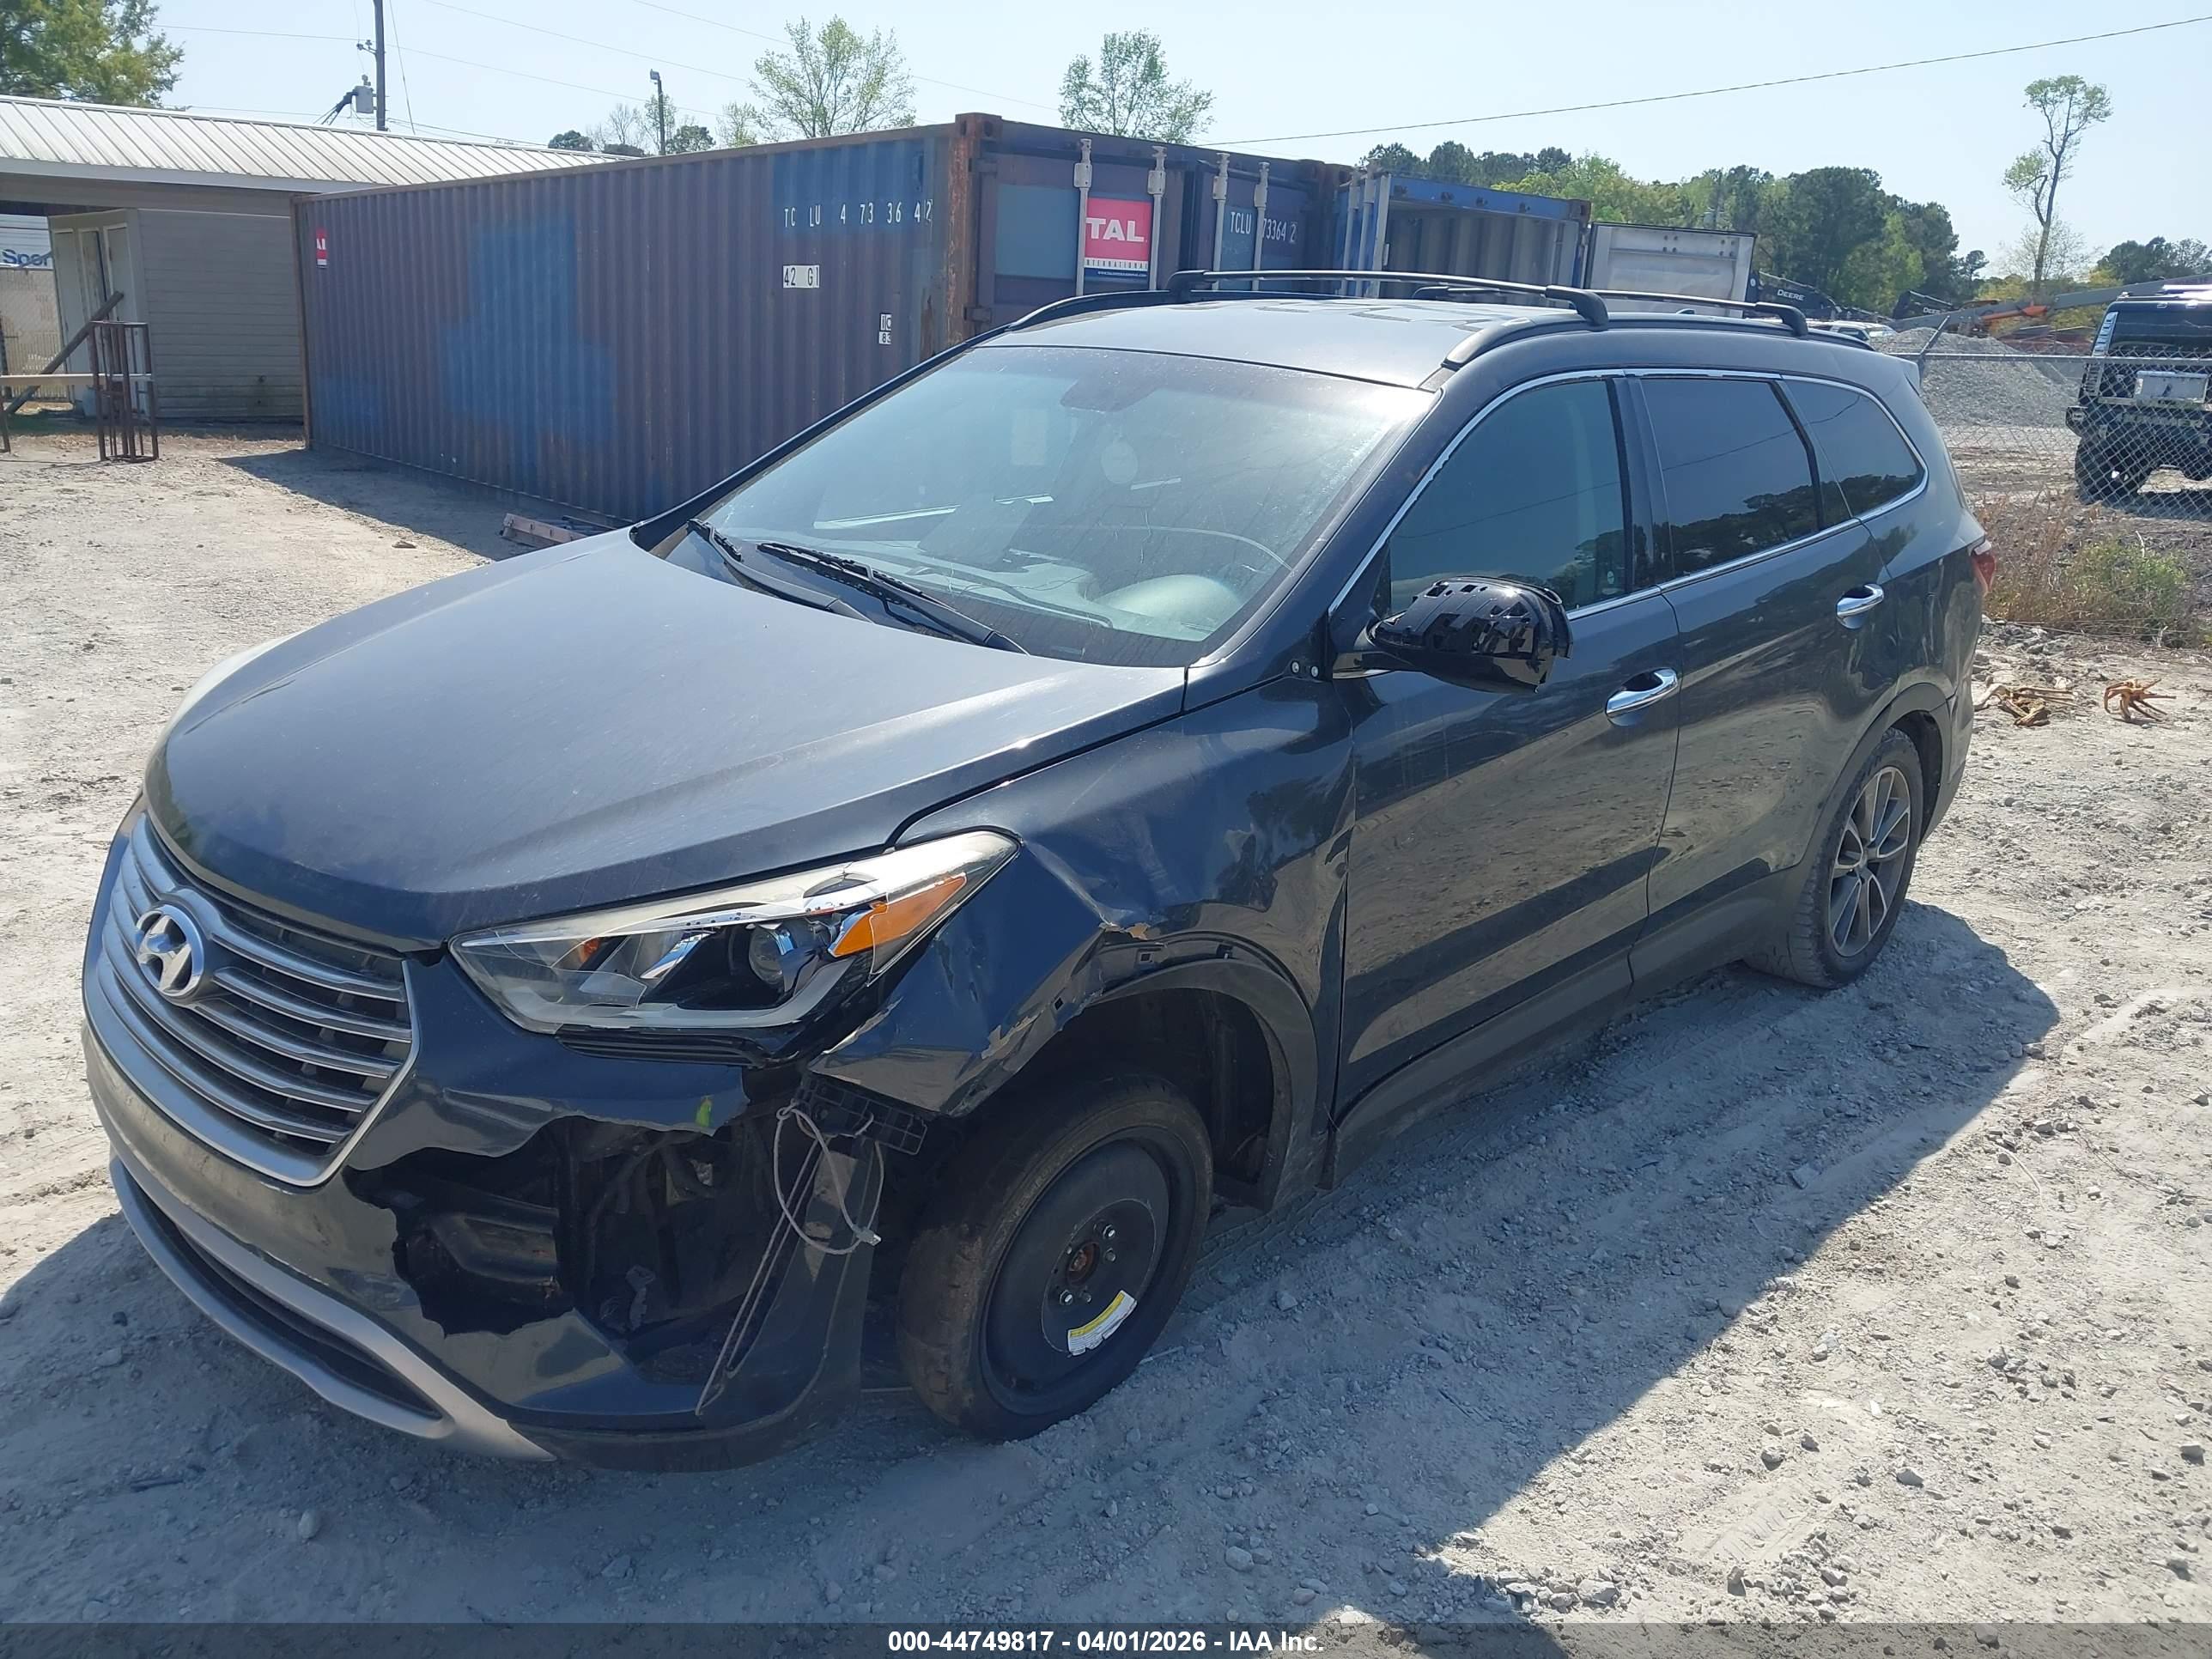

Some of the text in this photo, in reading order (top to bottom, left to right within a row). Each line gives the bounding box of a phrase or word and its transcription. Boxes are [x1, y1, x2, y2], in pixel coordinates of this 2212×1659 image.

[840, 204, 847, 225] 4
[1231, 211, 1252, 234] TCLU
[1085, 216, 1146, 242] TAL
[784, 266, 796, 286] 42
[1778, 289, 1805, 301] DEERE
